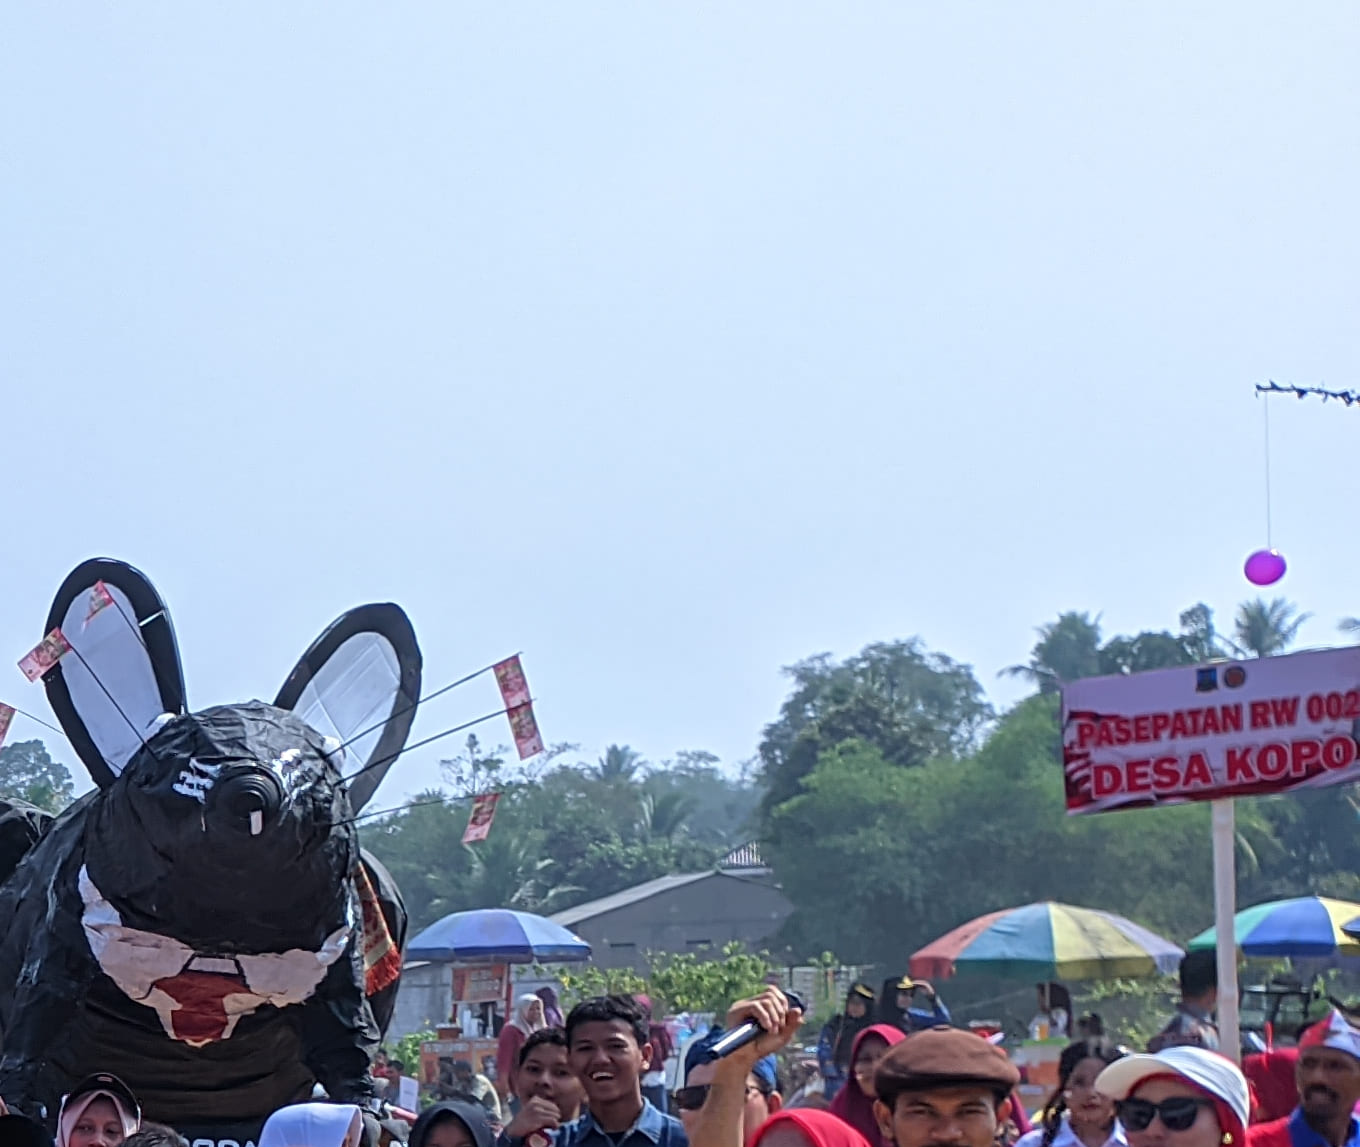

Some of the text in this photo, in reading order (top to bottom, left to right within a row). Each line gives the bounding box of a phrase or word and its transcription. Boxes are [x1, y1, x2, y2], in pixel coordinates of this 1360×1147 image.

[1077, 690, 1360, 748] PASEPATAN RW 002
[1092, 735, 1356, 799] DESA KOPO
